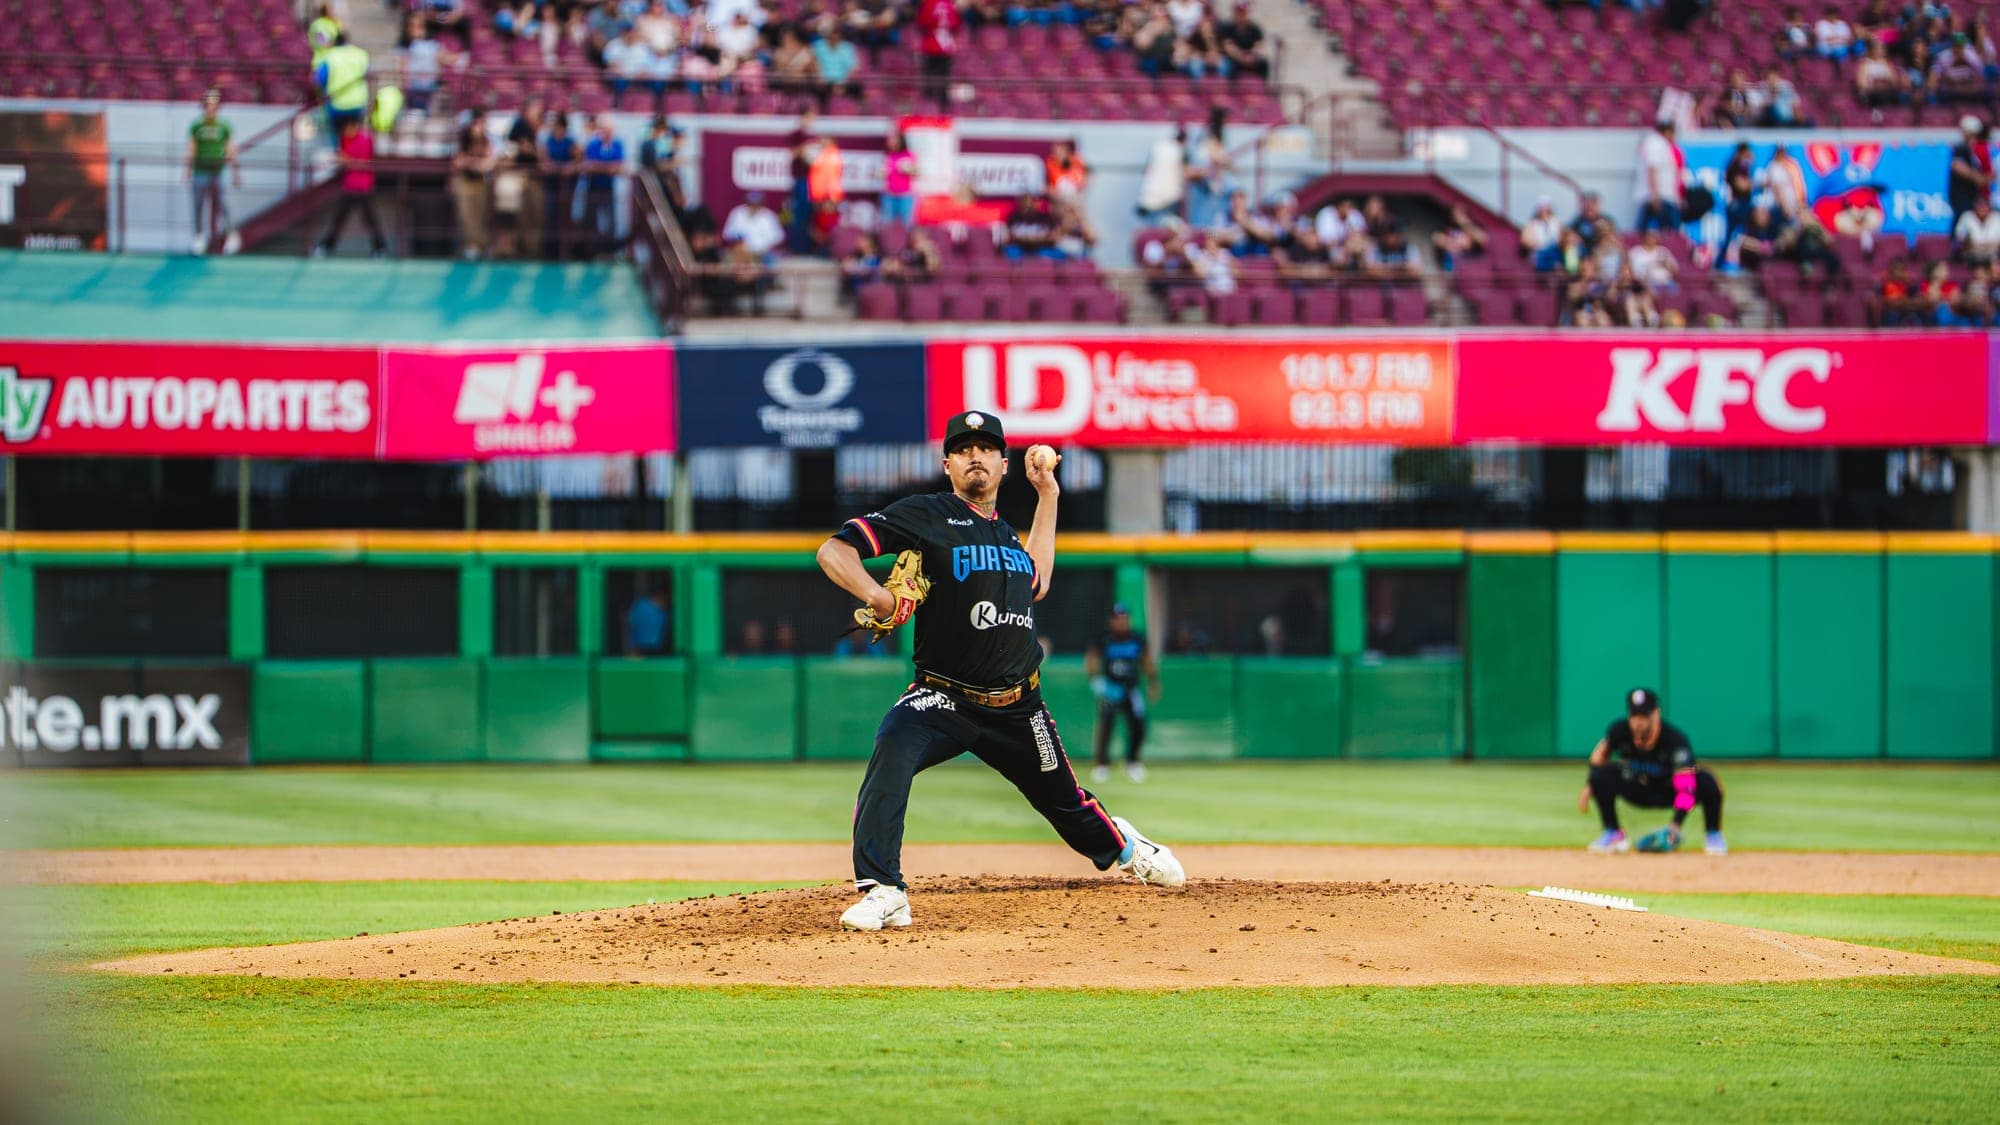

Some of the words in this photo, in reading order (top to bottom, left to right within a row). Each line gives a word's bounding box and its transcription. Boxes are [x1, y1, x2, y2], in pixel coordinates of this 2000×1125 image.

[963, 344, 1092, 437] LD
[1280, 353, 1373, 391] 101.7
[1376, 353, 1433, 391] FM
[1597, 347, 1832, 432] KFC
[57, 376, 371, 432] AUTOPARTES
[1095, 387, 1236, 432] Directa
[1367, 391, 1424, 430] FM
